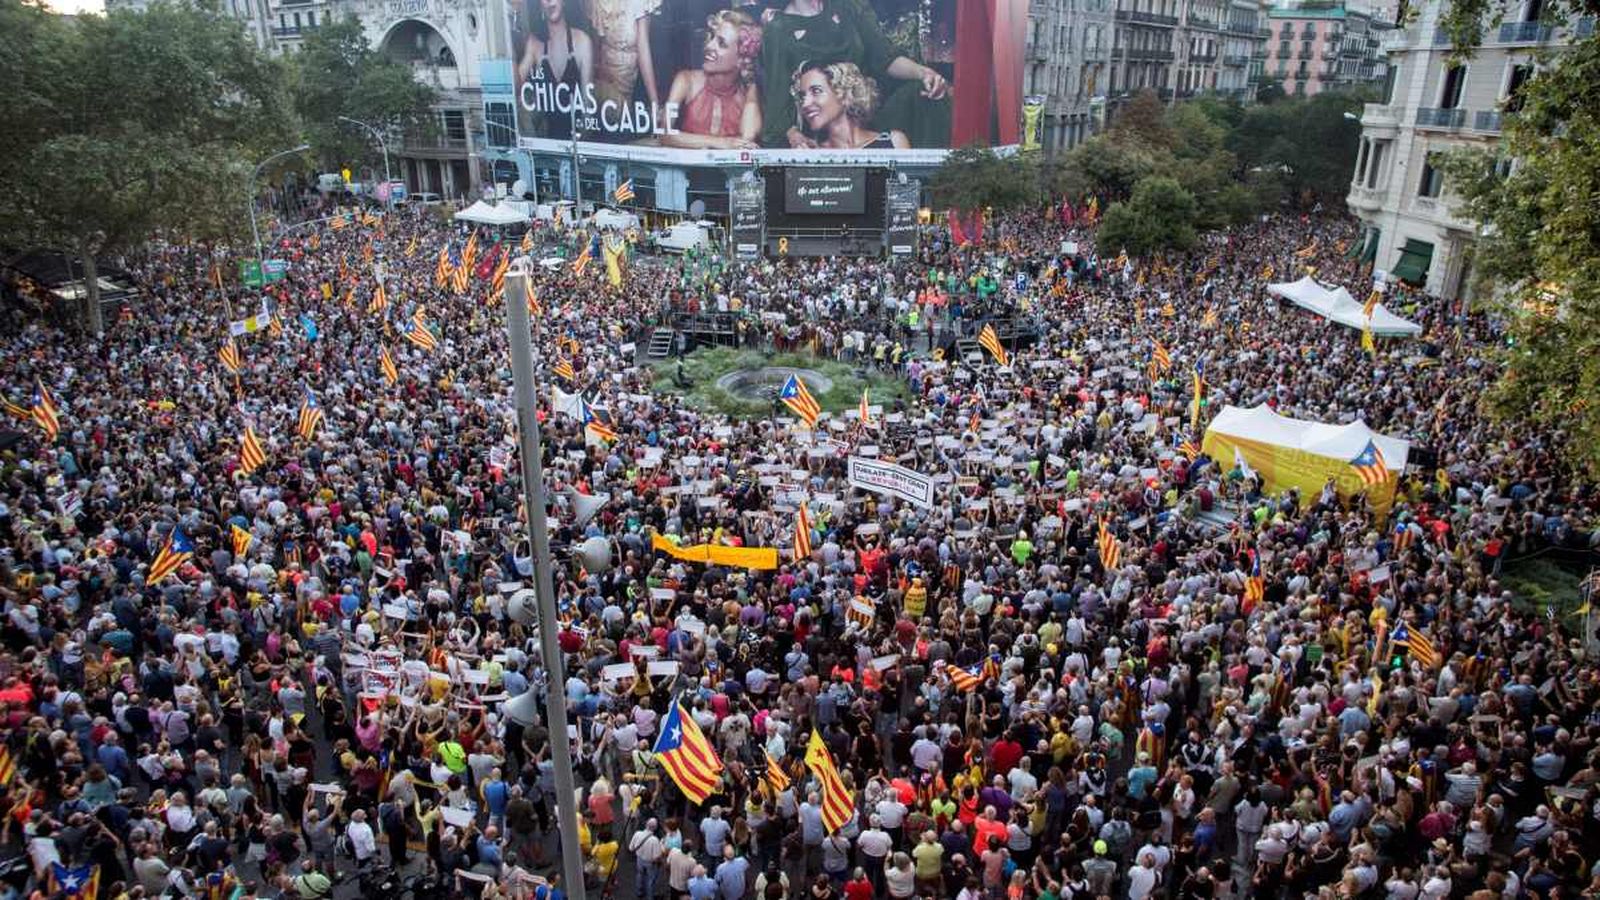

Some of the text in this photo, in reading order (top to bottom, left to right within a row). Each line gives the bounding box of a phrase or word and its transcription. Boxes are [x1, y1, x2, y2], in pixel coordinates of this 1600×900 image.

[531, 67, 545, 79] LAS
[520, 82, 598, 114] CHICAS
[585, 100, 680, 135] DEL CABLE
